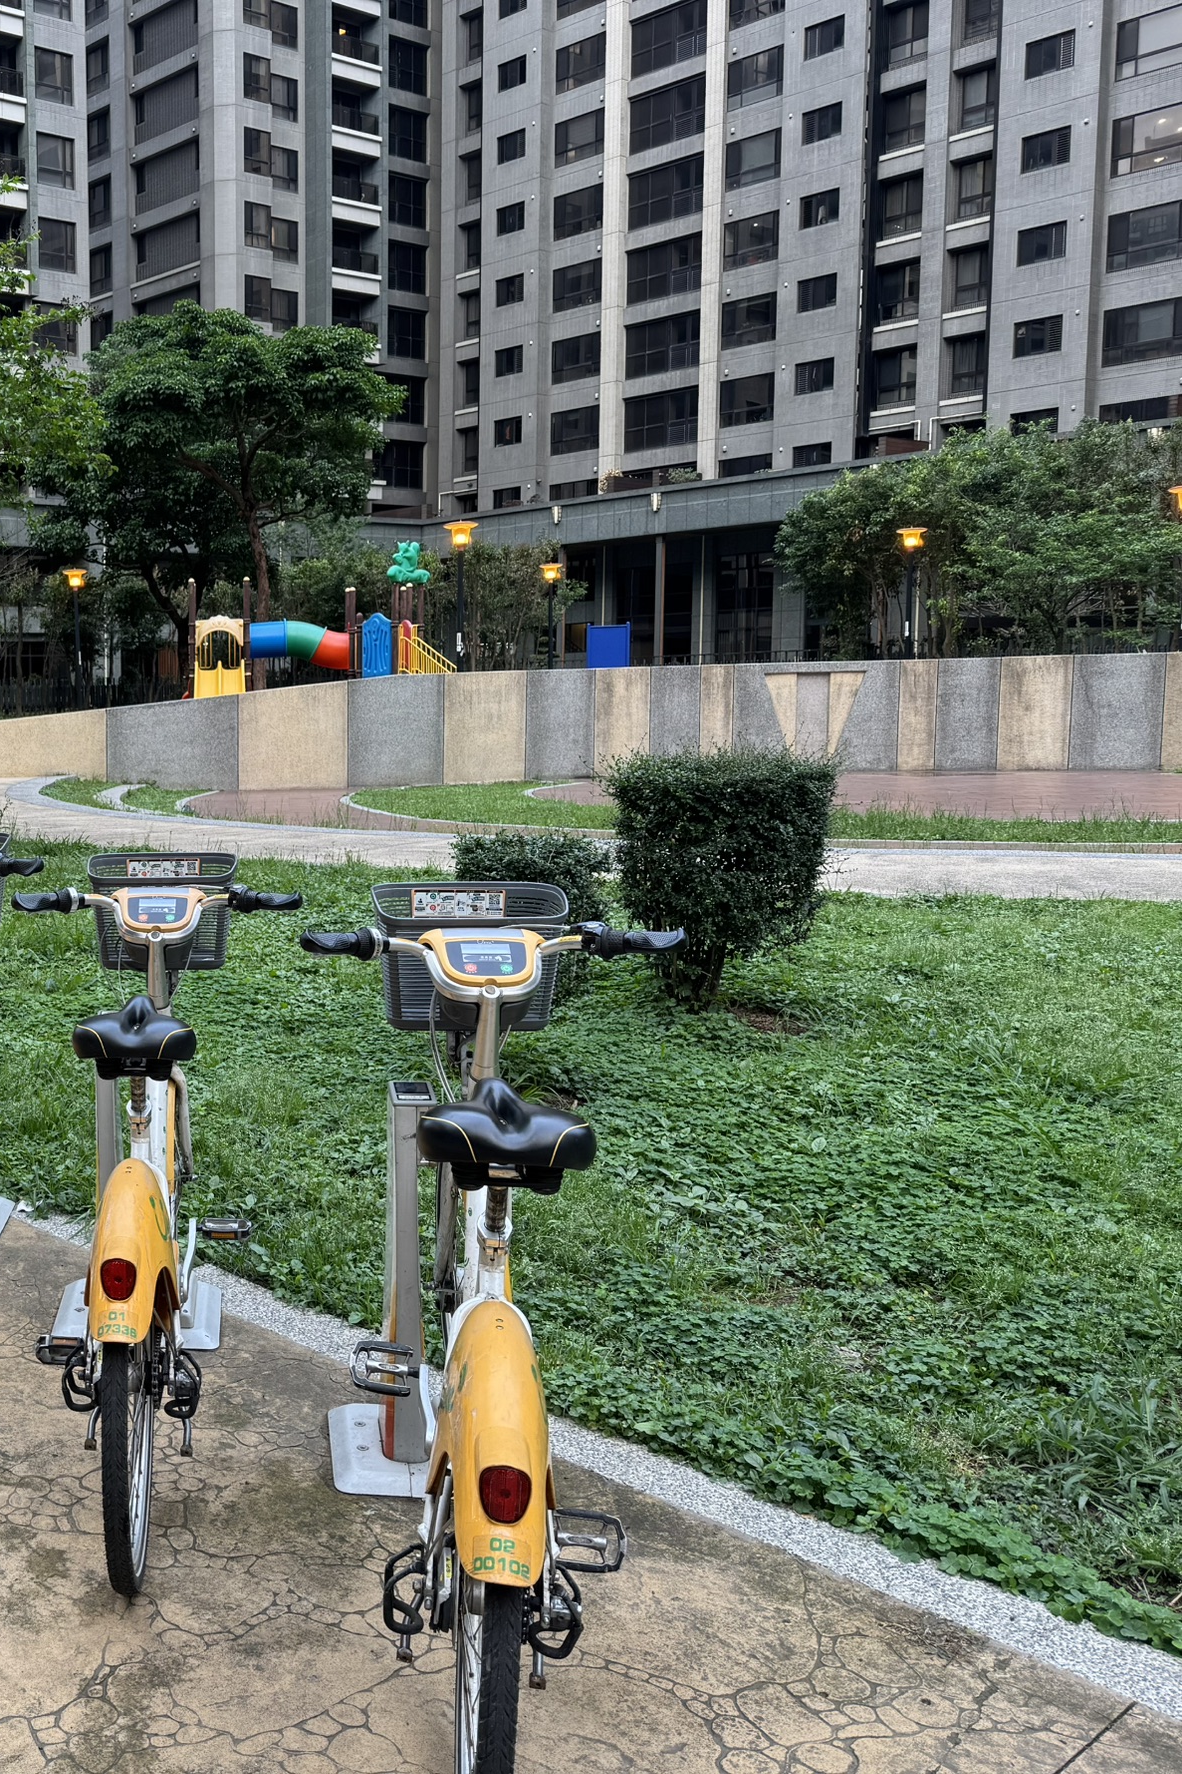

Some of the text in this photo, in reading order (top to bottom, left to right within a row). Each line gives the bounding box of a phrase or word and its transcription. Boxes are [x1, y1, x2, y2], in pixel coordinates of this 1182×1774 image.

[108, 1311, 125, 1321] 01
[489, 1537, 515, 1553] 02
[473, 1556, 530, 1579] 00102
